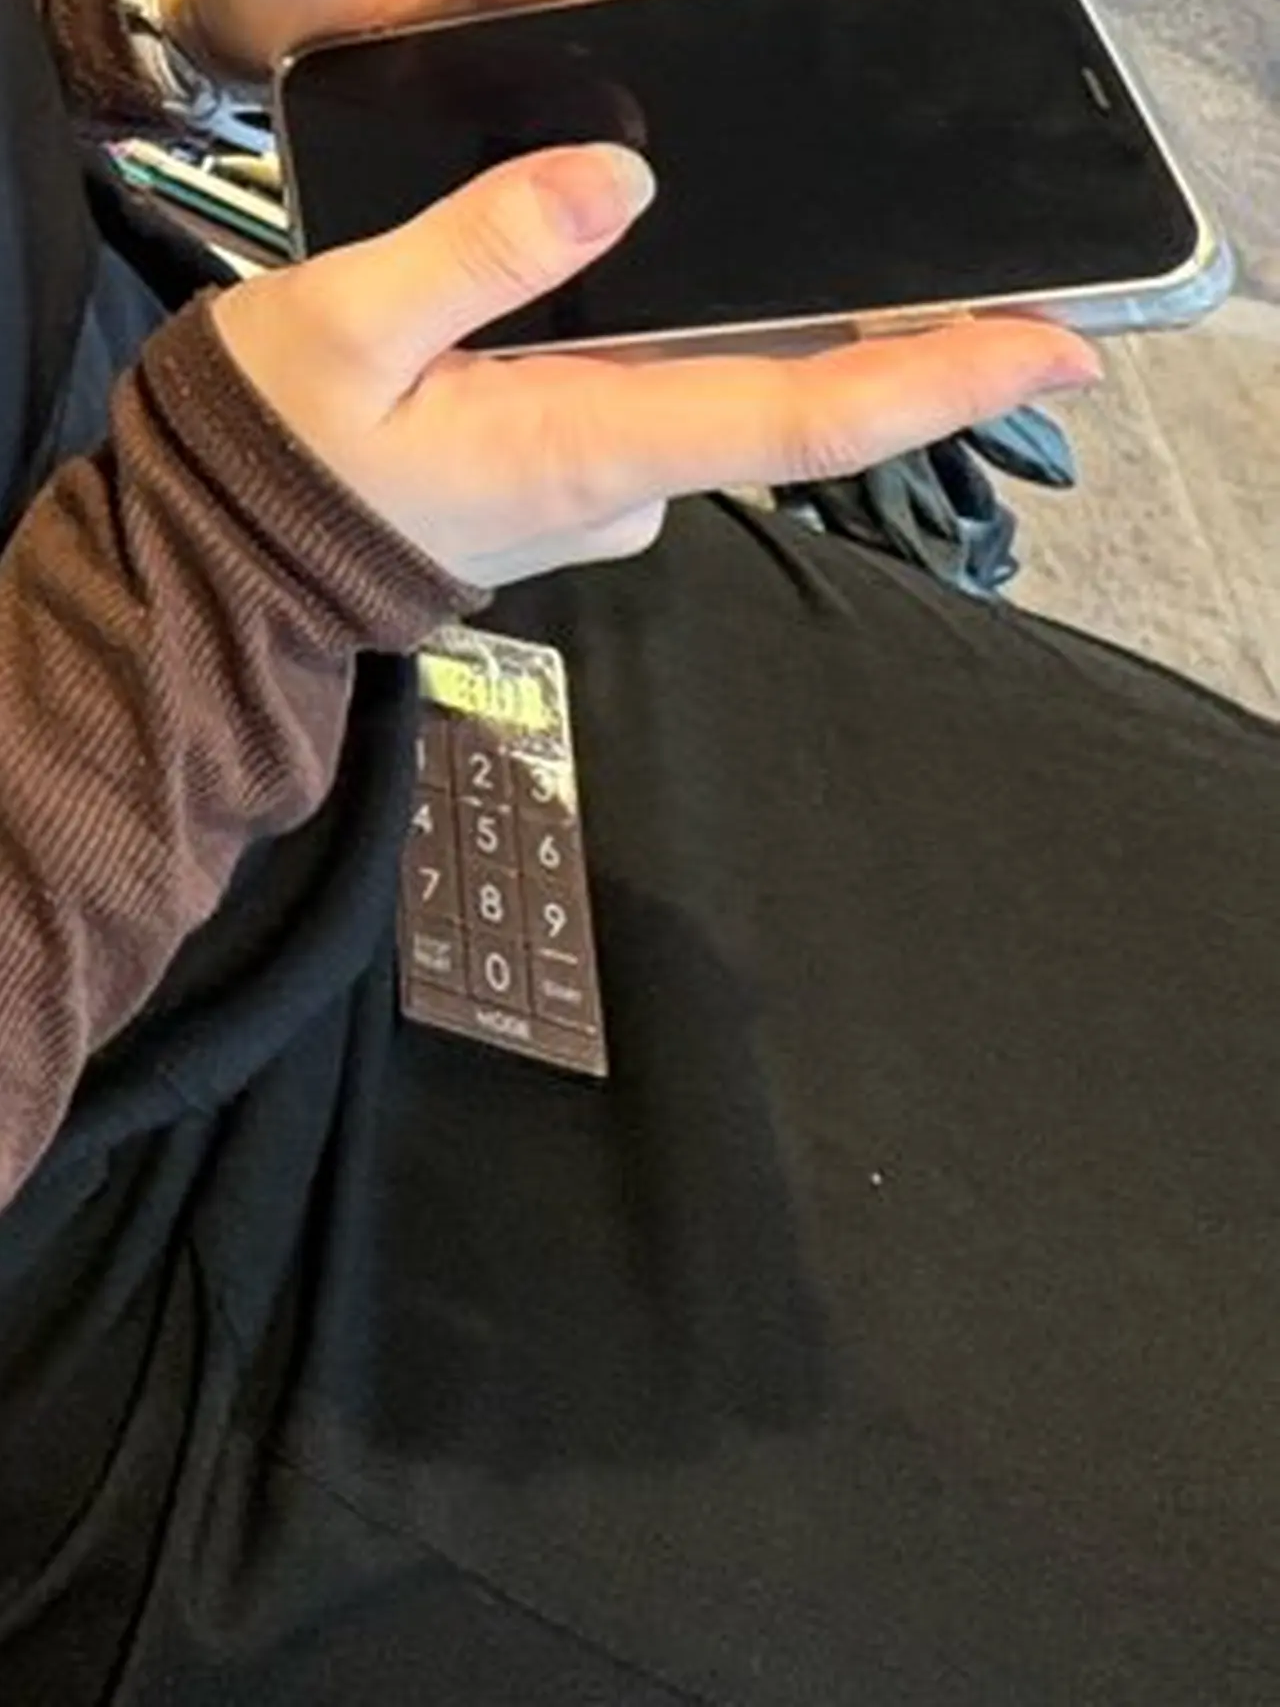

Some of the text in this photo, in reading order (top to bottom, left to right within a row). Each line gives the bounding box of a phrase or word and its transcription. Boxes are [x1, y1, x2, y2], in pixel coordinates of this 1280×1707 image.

[468, 754, 494, 790] 2
[530, 768, 555, 803] 3
[411, 803, 561, 870] 4 5 6
[417, 869, 567, 938] 7 8 9
[485, 952, 510, 992] 0
